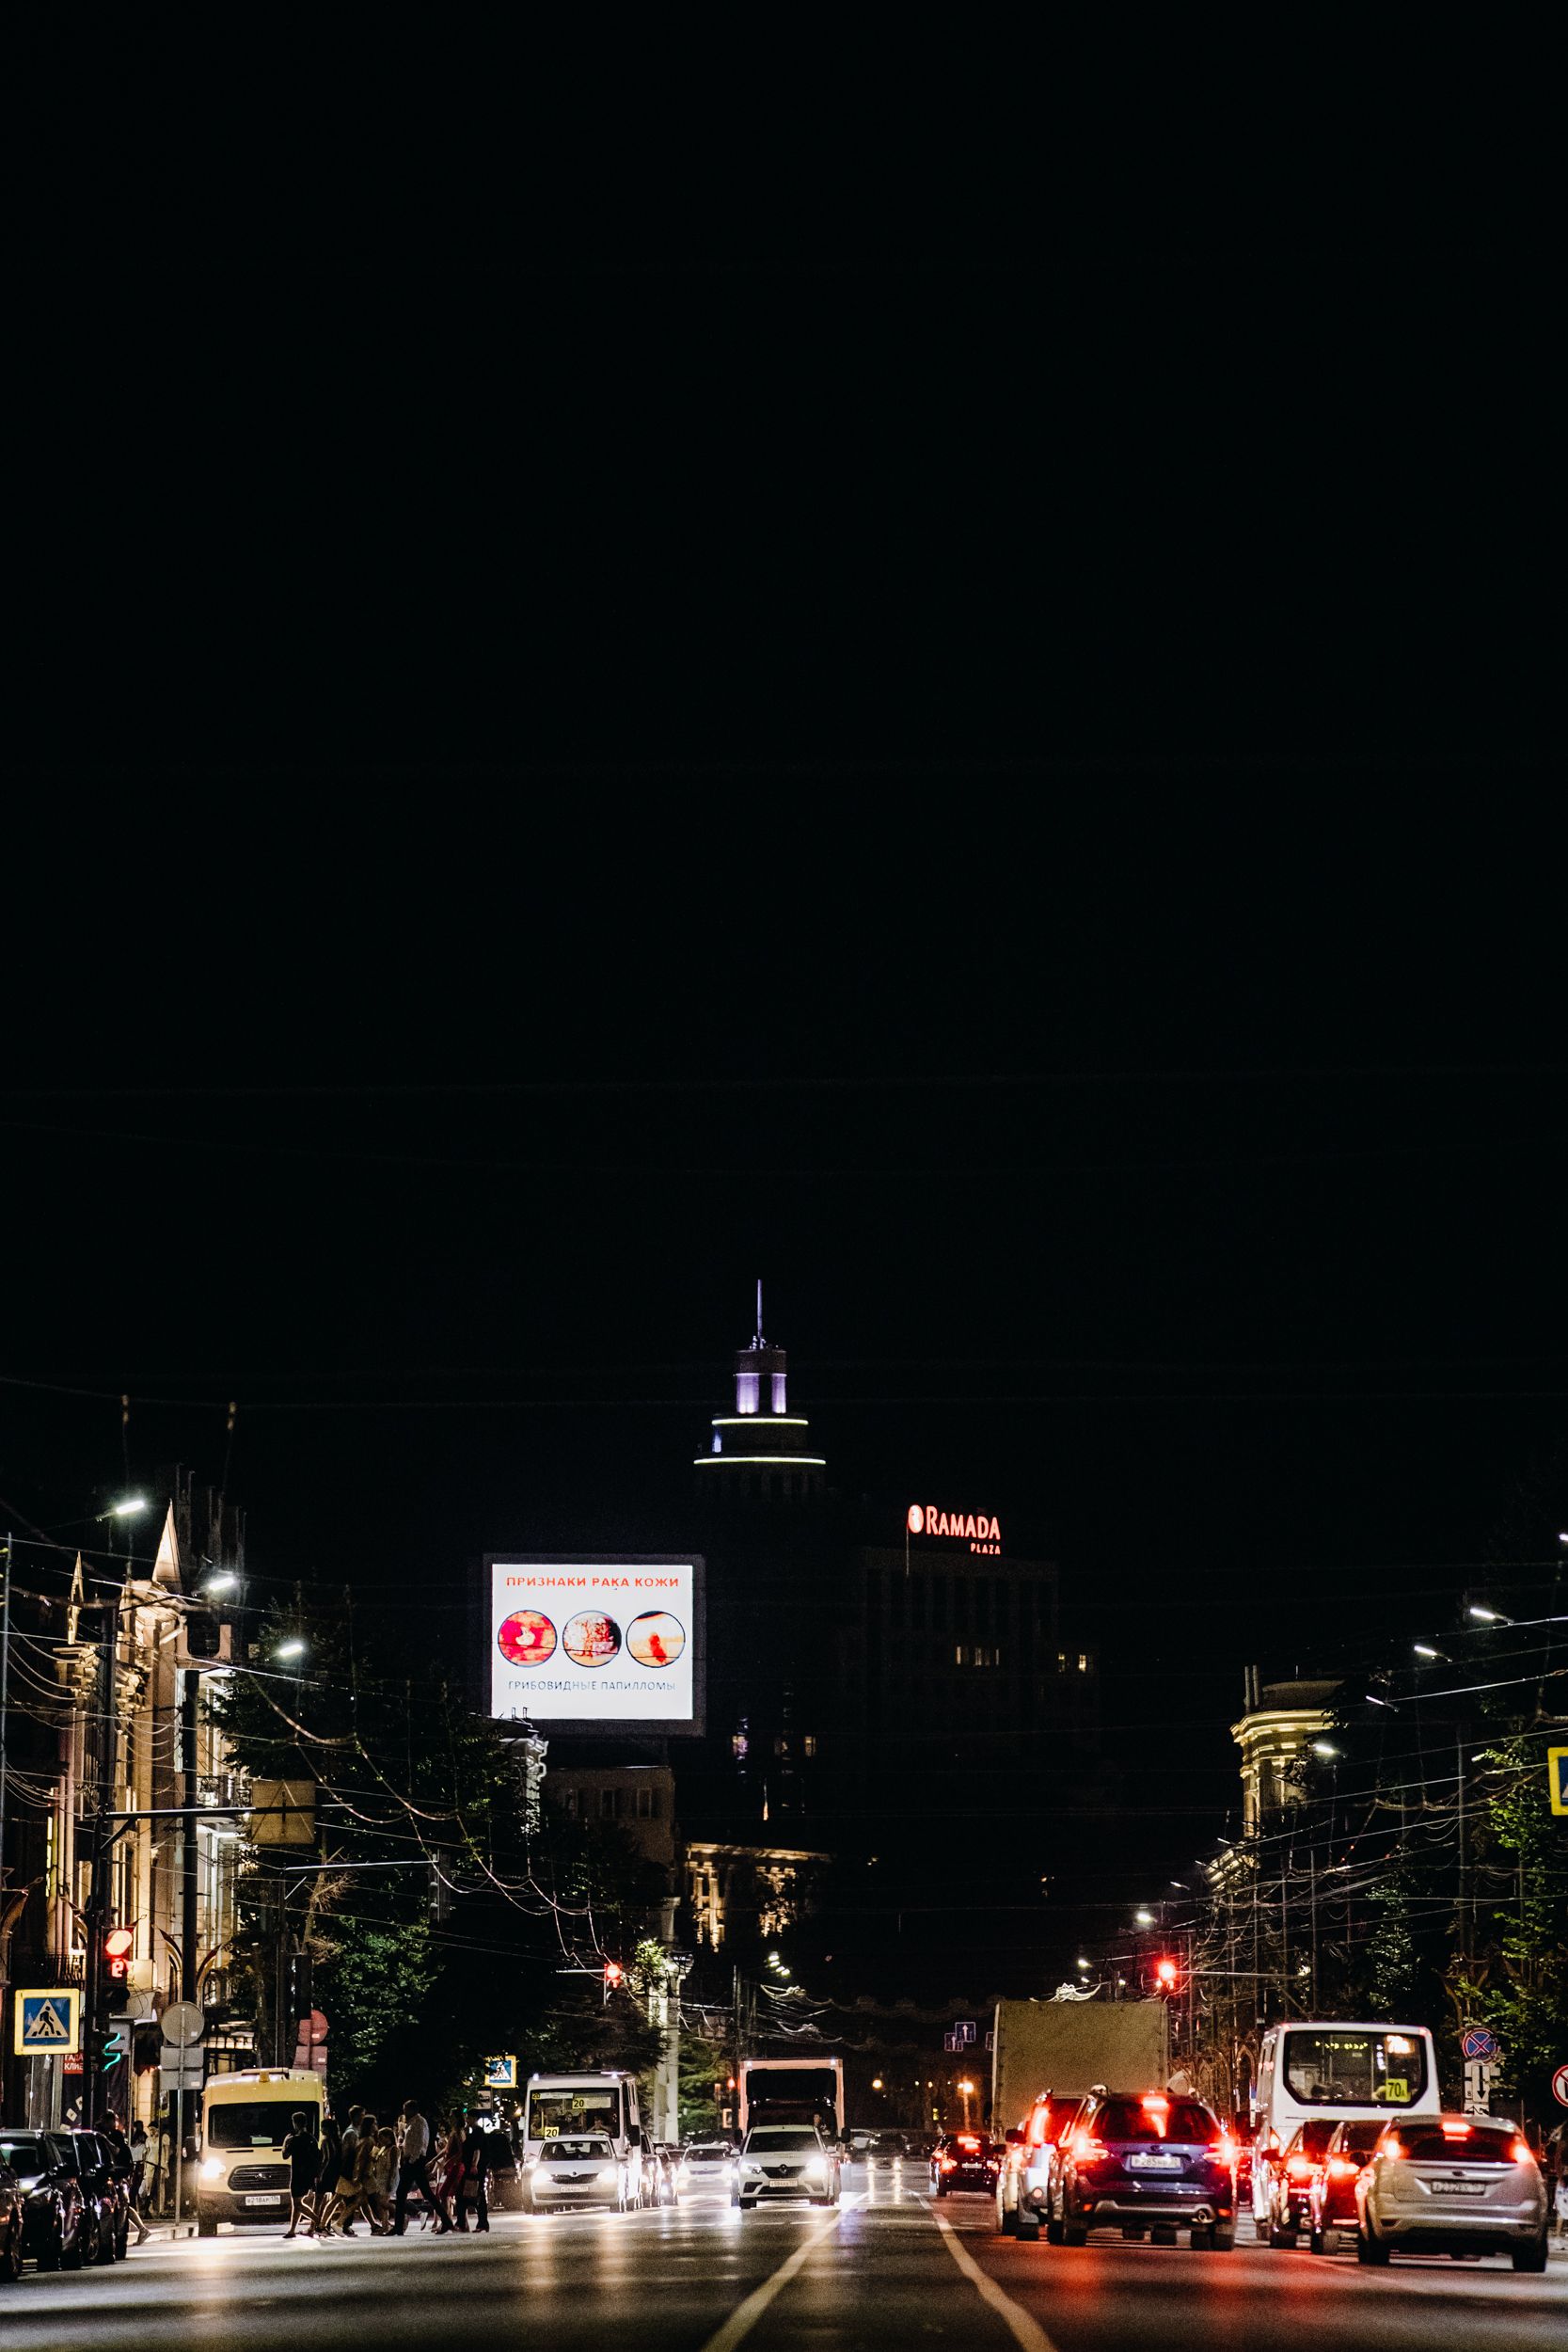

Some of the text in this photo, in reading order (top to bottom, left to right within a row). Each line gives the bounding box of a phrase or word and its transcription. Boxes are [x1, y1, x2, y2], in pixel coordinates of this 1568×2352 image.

[926, 1505, 1001, 1540] RAMADA
[970, 1543, 1001, 1555] PLAZA
[506, 1577, 679, 1587] ПРИЗНАКИ РАКА КОЖИ
[508, 1680, 675, 1691] ГРИБОВИДНЫЕ ПАПИЛЛОМЫ
[64, 2062, 84, 2071] КЛИЕ
[573, 2099, 585, 2108] 20
[546, 2128, 558, 2137] 20
